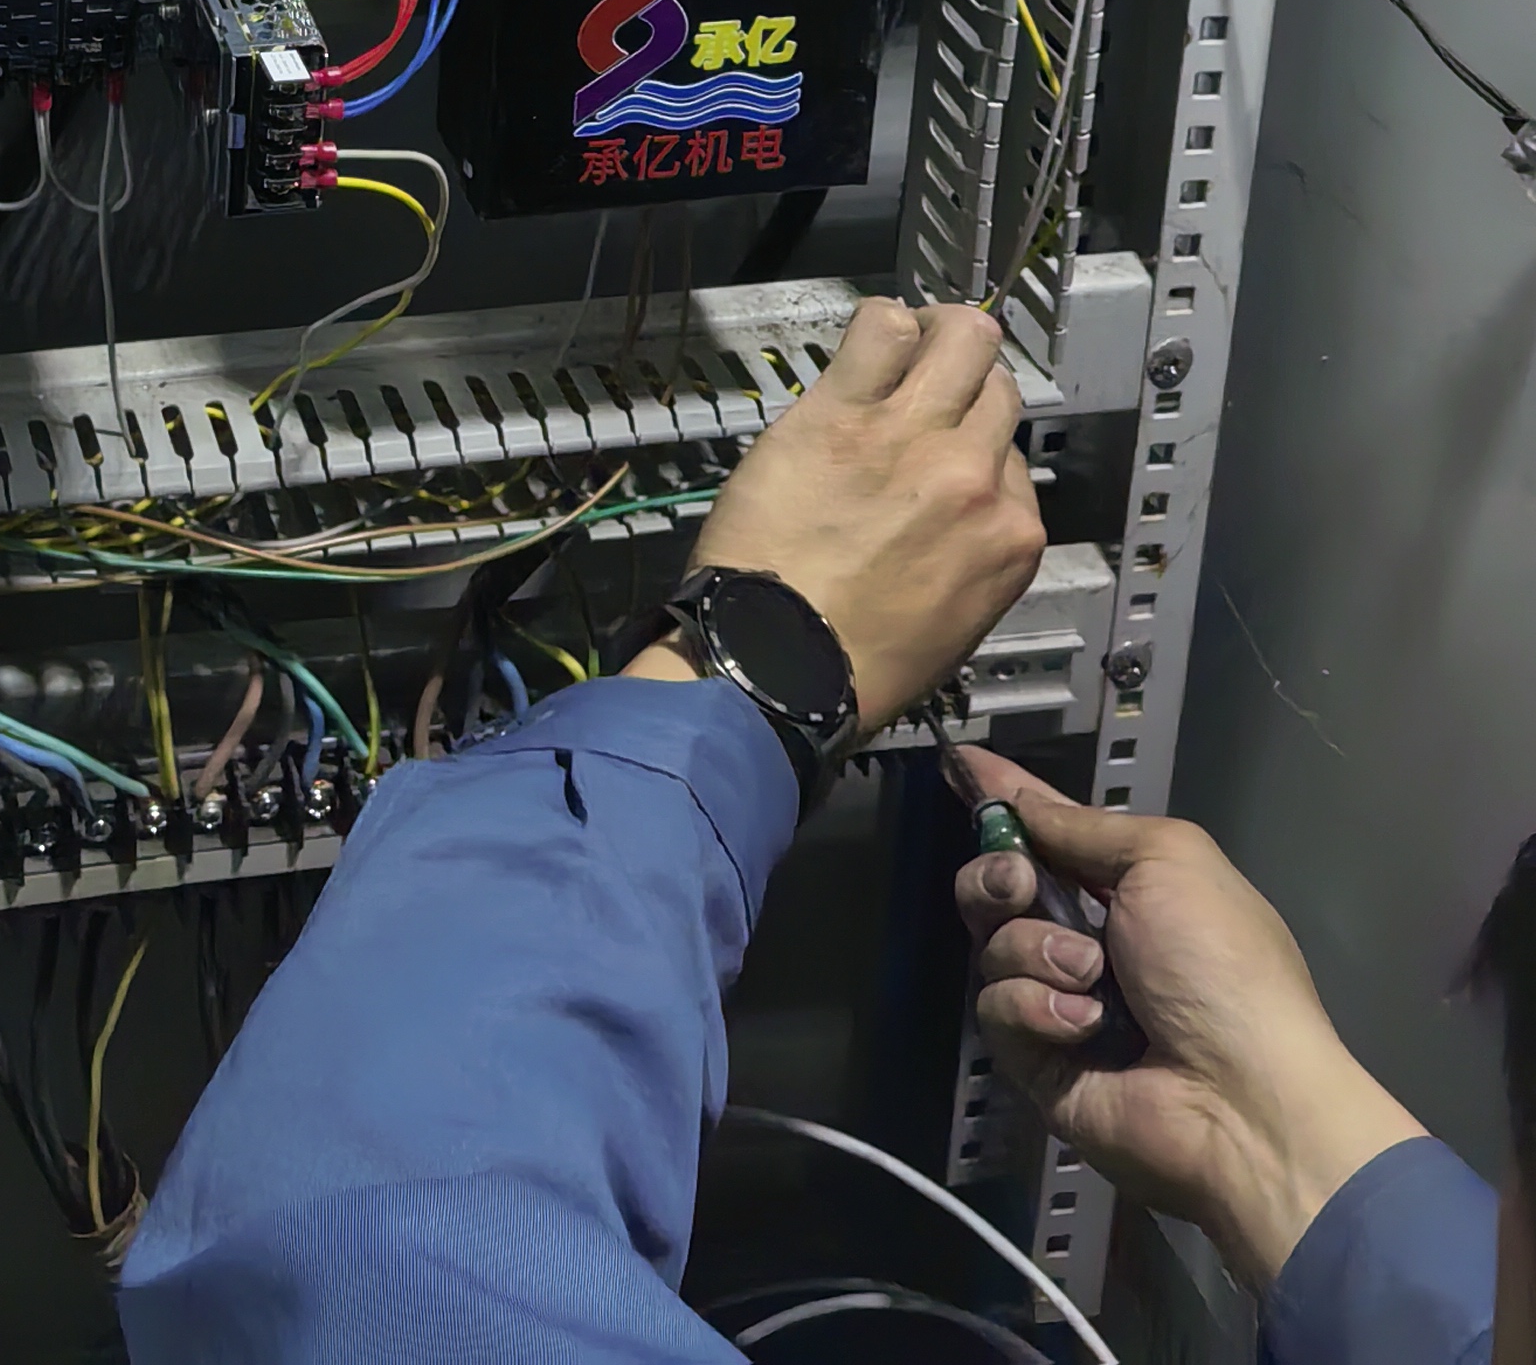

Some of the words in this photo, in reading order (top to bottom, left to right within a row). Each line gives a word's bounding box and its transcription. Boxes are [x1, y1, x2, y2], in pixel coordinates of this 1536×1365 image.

[690, 14, 798, 71] 承亿
[579, 124, 787, 186] 承亿机电
